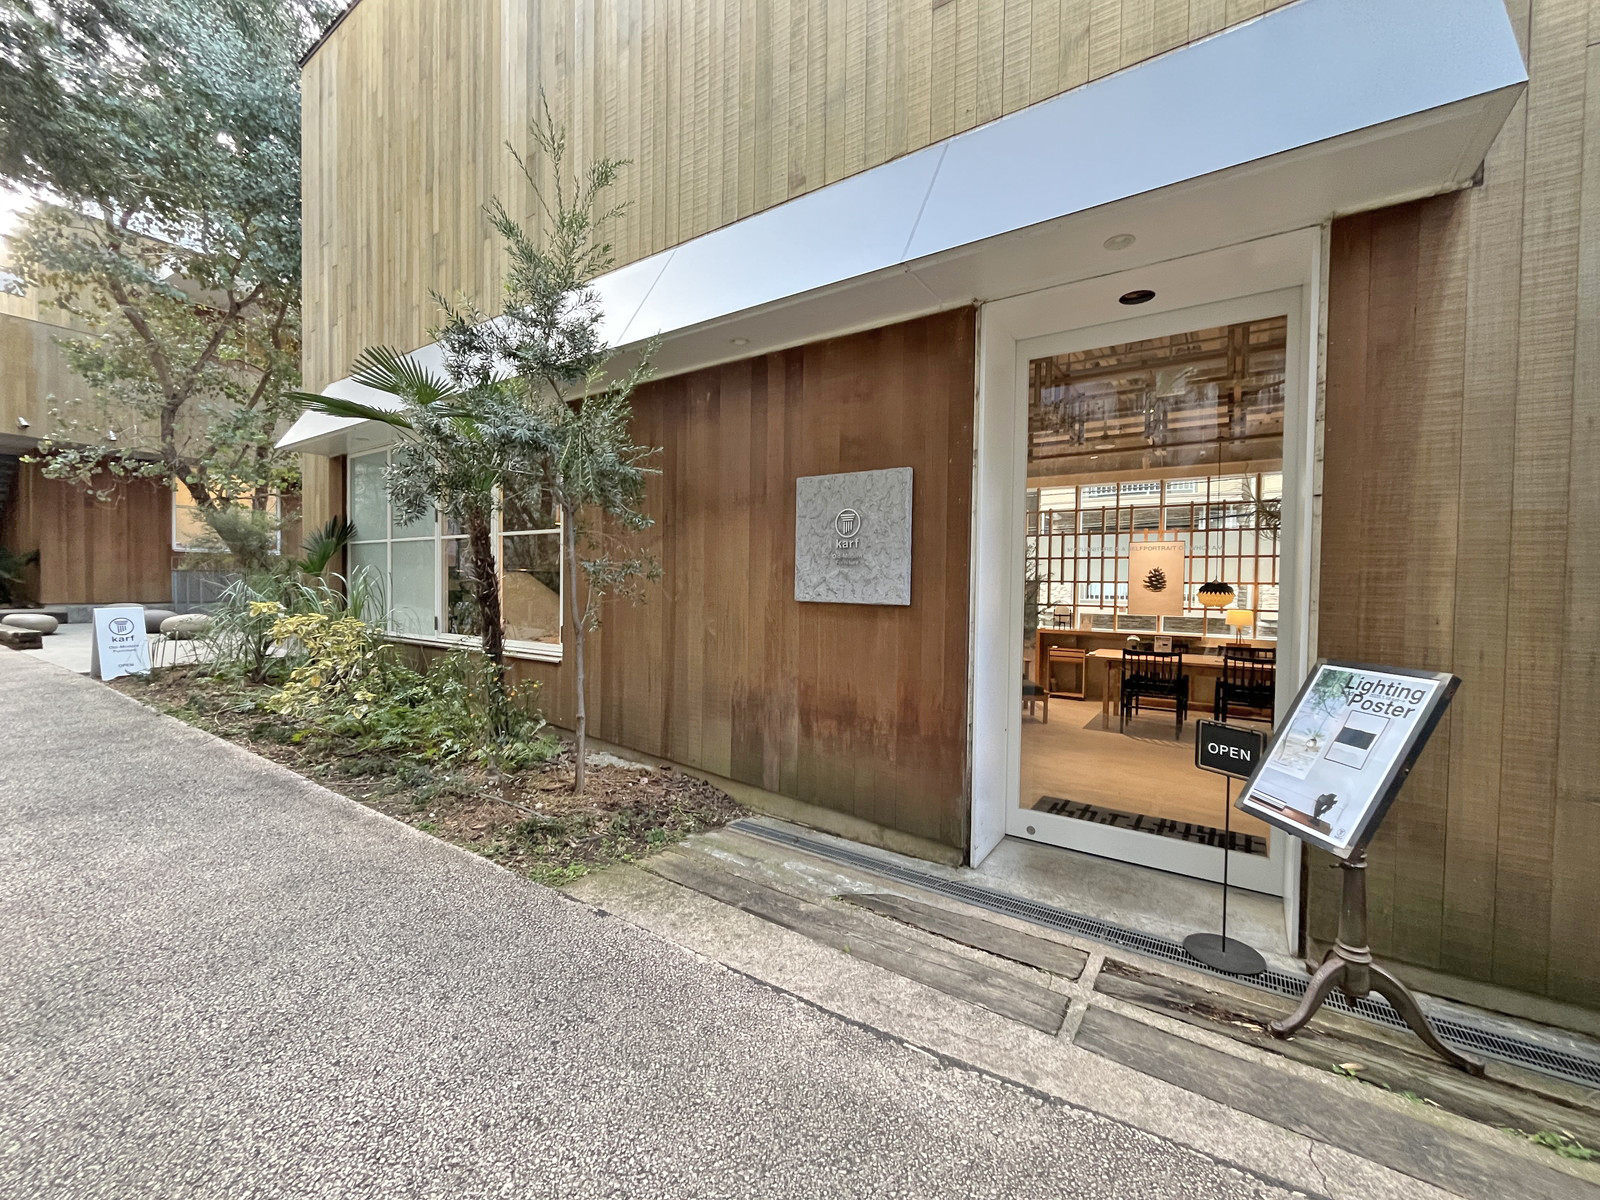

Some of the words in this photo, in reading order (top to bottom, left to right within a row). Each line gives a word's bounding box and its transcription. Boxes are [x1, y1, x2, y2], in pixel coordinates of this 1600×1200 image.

[835, 537, 860, 549] karf
[1344, 675, 1427, 705] Lighting
[1346, 693, 1416, 718] Poster
[1207, 742, 1251, 762] OPEN
